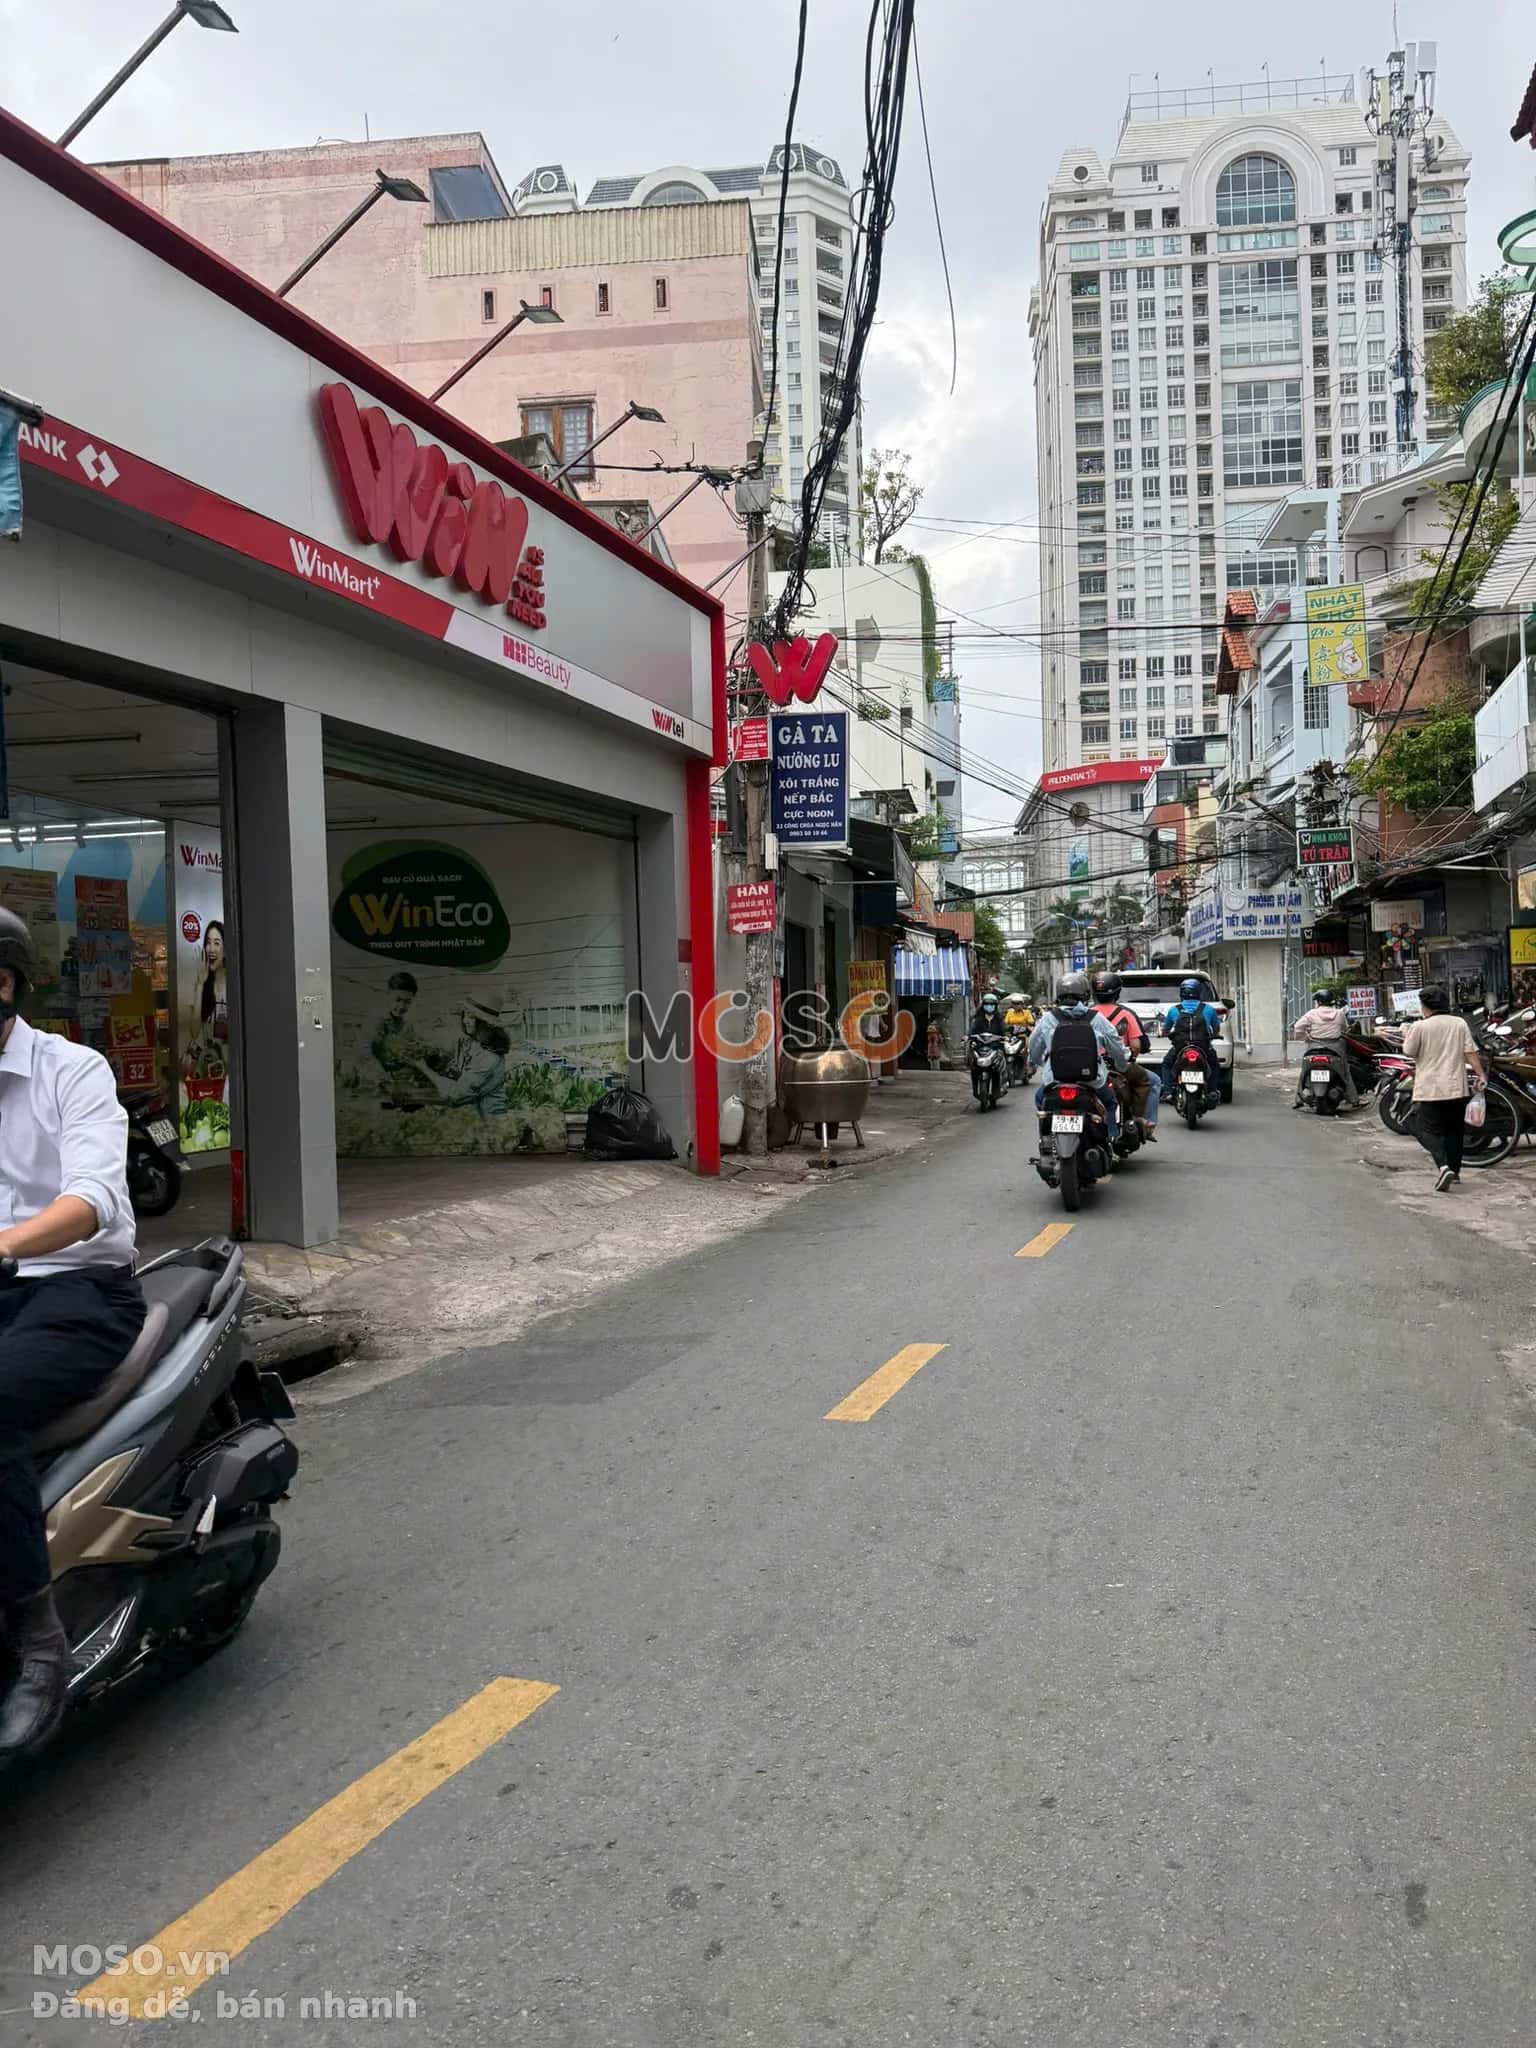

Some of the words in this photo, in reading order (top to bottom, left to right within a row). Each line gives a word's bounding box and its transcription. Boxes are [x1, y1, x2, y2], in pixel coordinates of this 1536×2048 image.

[512, 581, 545, 608] YOU
[507, 600, 546, 629] NEED
[778, 721, 806, 744] GÀ
[811, 724, 838, 743] TA
[777, 751, 821, 769] NƯỚNG
[823, 753, 840, 768] LU
[806, 809, 834, 818] NGON
[737, 884, 768, 898] HÀN
[349, 892, 493, 936] WinEco
[1264, 915, 1280, 925] NAM
